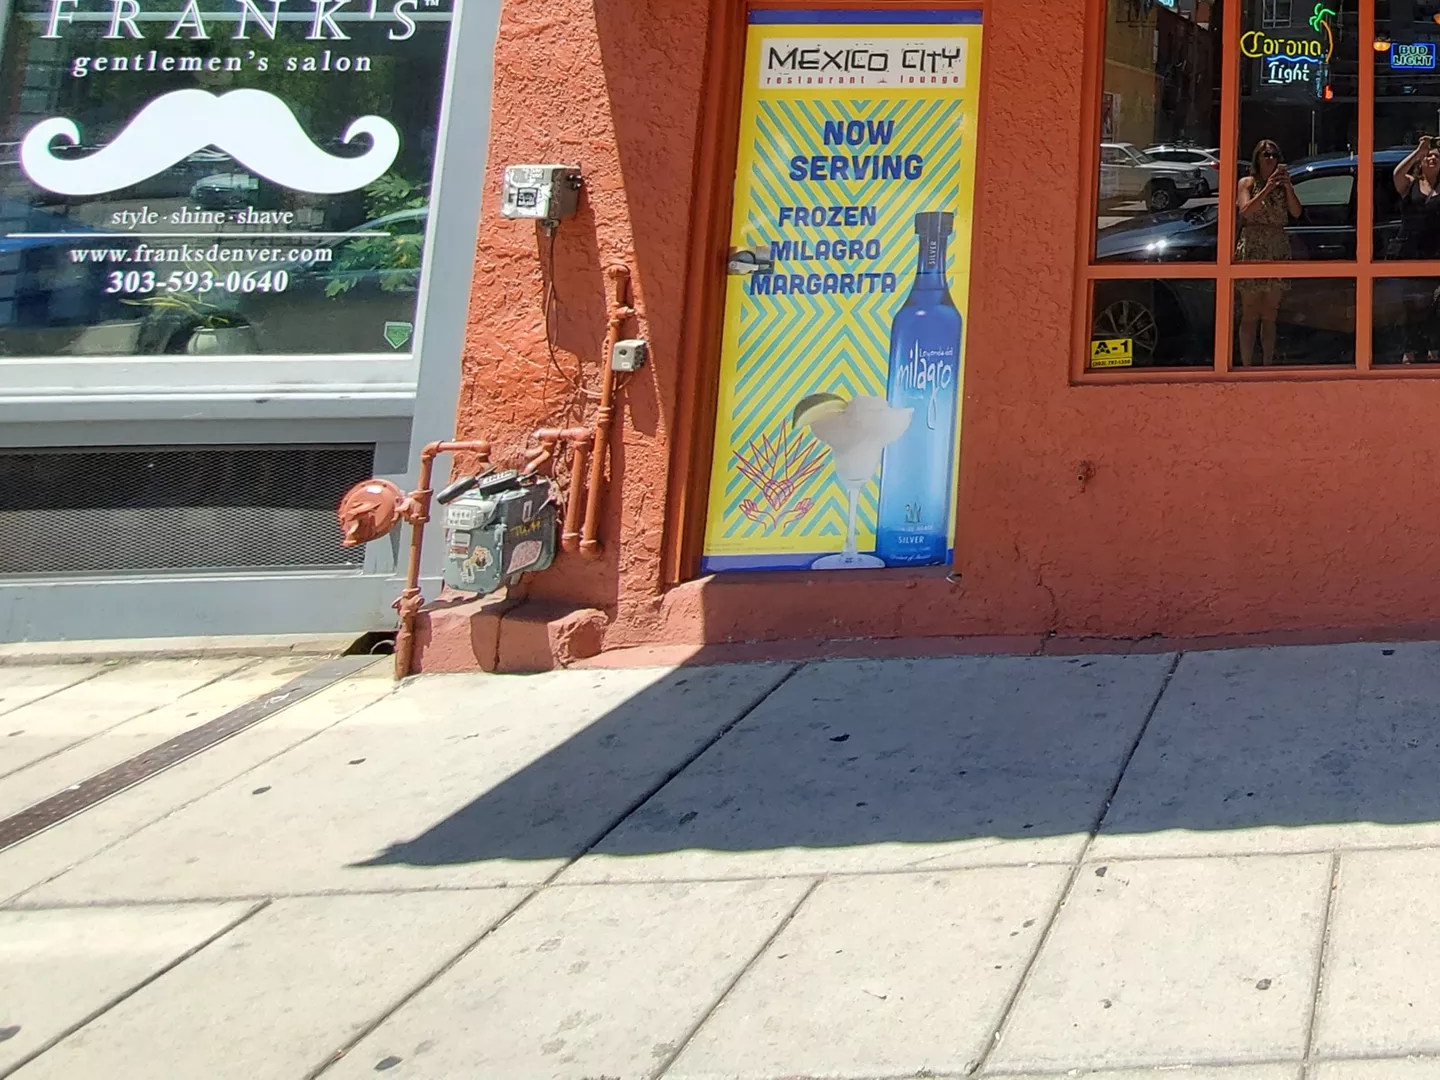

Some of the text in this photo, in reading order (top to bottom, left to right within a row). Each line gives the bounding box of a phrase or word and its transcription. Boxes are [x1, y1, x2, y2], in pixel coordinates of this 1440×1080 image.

[1240, 31, 1321, 58] Corona
[1399, 45, 1428, 56] BUD
[72, 50, 372, 78] gentlemen's salon
[768, 46, 961, 73] MEXICO CITY
[1393, 55, 1433, 66] LIGHT
[767, 74, 959, 85] restaurant lounge
[1268, 61, 1310, 83] Light
[823, 120, 895, 146] NOW
[789, 154, 923, 181] SERVING
[112, 207, 294, 230] style shine shave
[778, 206, 877, 227] FROZEN
[70, 243, 333, 263] www.franksdenver.com
[769, 239, 881, 262] MILAGRO
[105, 270, 289, 293] 303-593-0640
[750, 272, 897, 296] MARGARITA
[1094, 340, 1129, 355] A-1
[898, 338, 953, 430] milagro
[898, 536, 925, 544] SILVER
